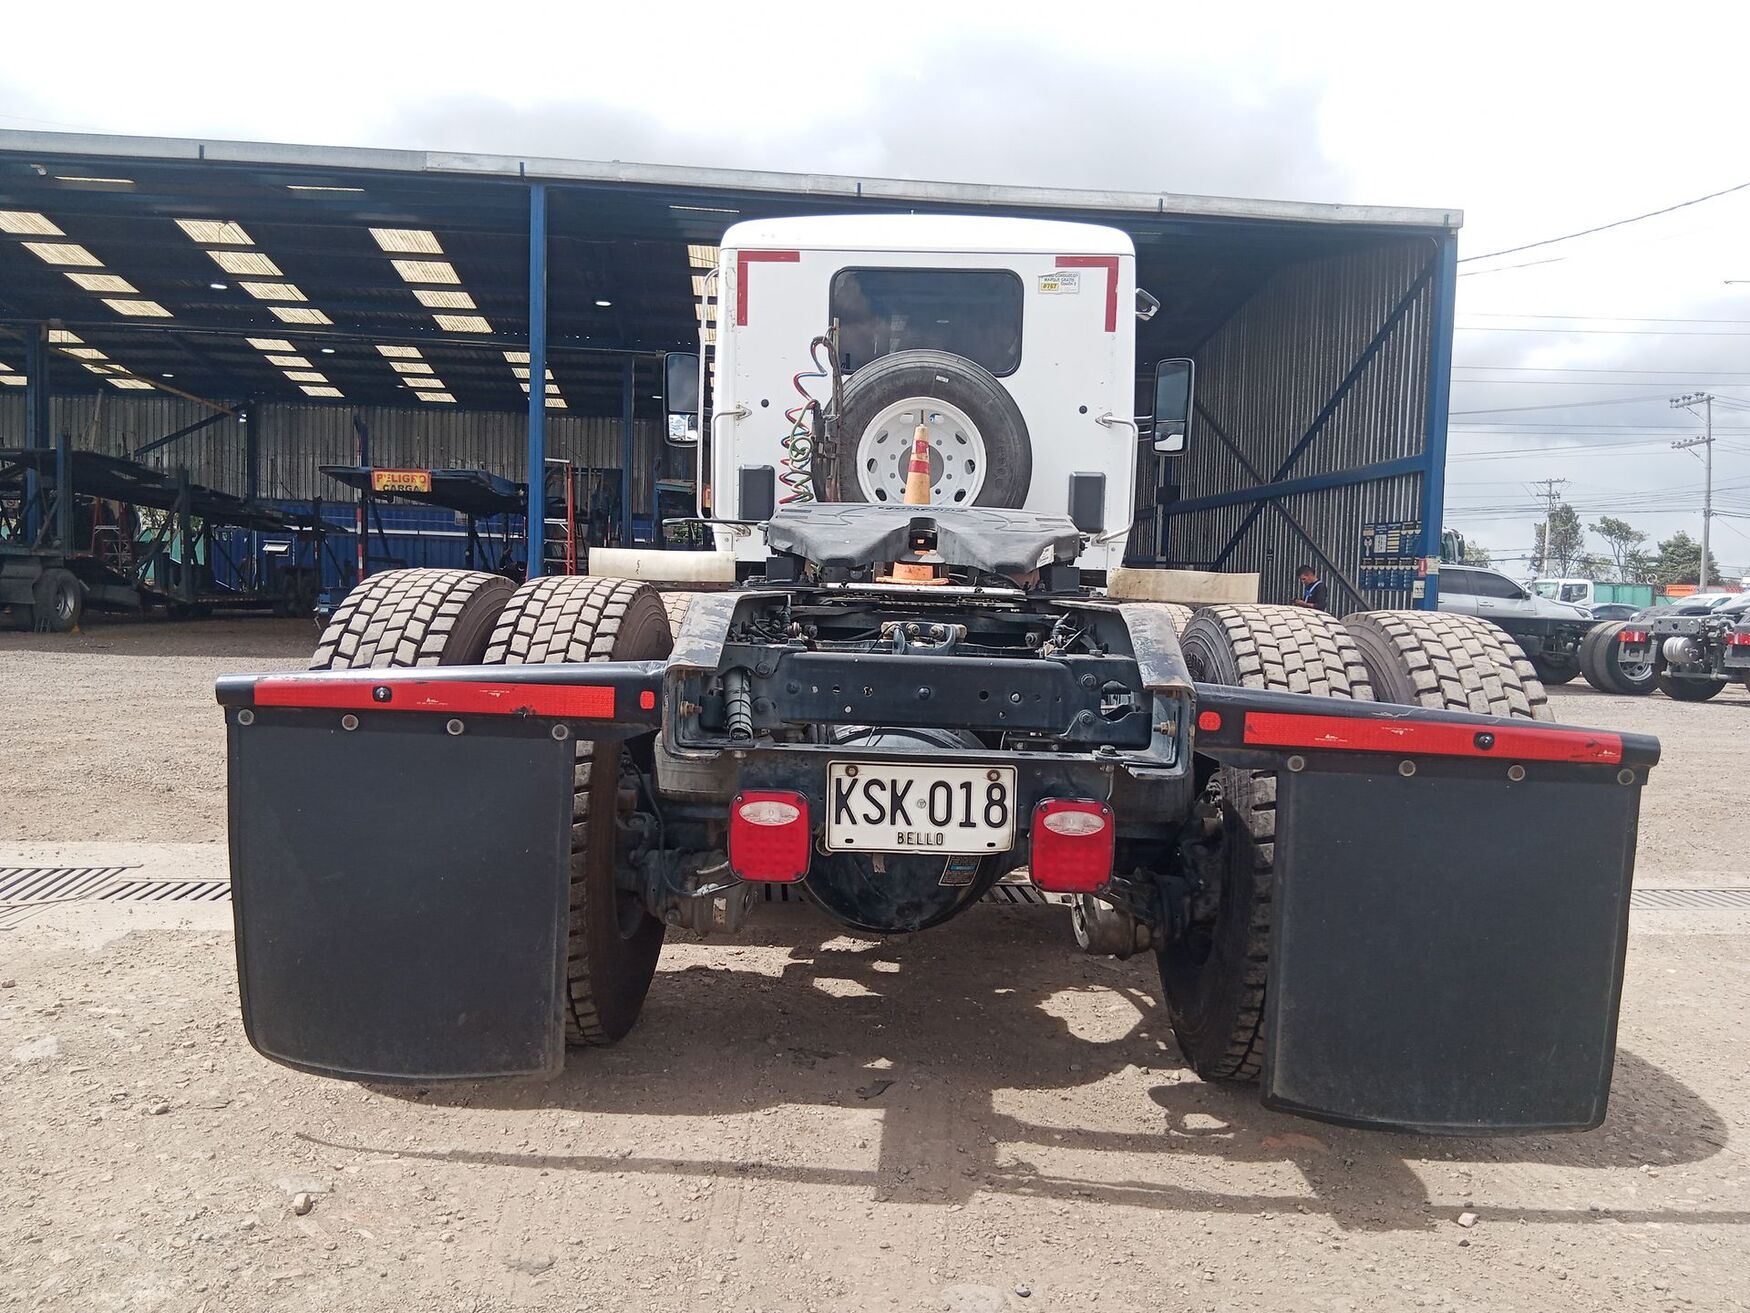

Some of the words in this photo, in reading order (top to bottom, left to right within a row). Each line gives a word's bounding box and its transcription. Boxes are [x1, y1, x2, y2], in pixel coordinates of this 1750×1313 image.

[834, 777, 914, 826] KSK
[928, 780, 1008, 828] 018
[897, 832, 944, 846] BELLO
